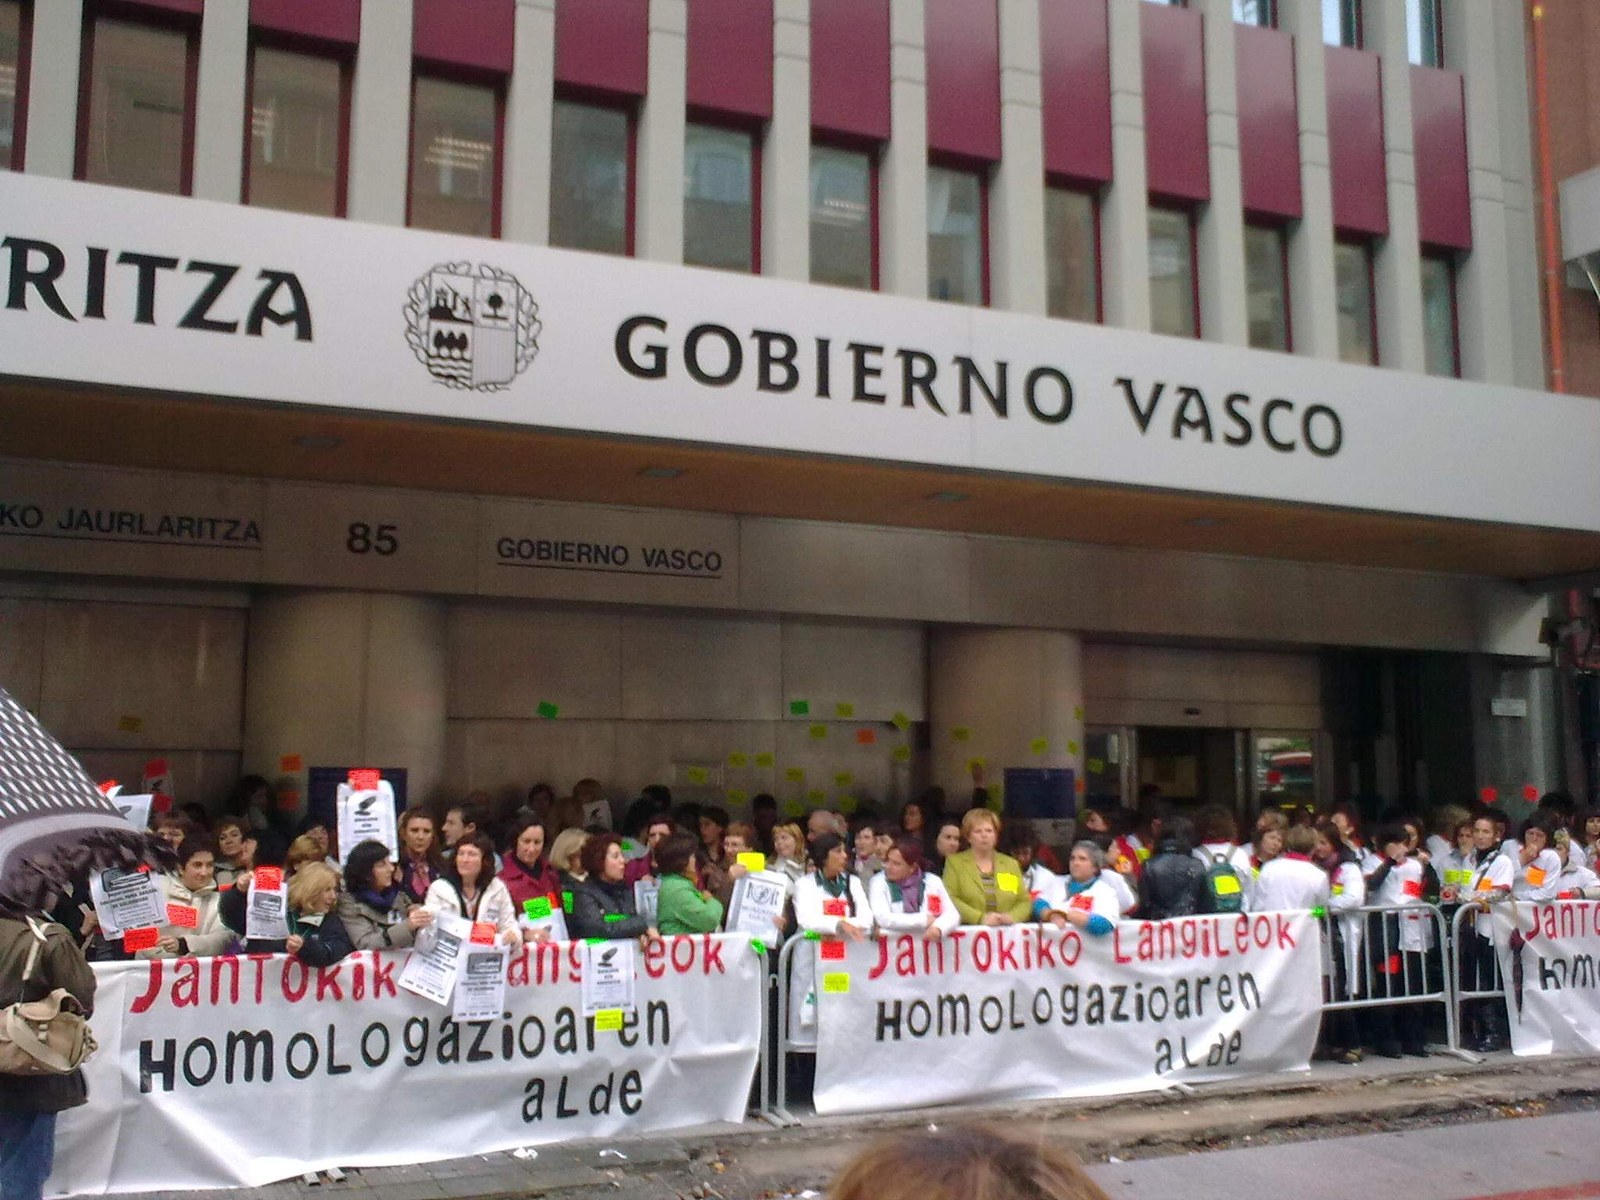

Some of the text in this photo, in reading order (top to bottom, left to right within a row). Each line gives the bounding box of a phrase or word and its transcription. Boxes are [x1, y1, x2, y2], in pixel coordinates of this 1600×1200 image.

[1, 236, 314, 342] RITZA
[614, 315, 1344, 458] GOBIERNO VASCO
[57, 508, 262, 543] JAURLARITZA
[346, 522, 398, 556] 85
[497, 537, 722, 572] GOBIERNO VASCO
